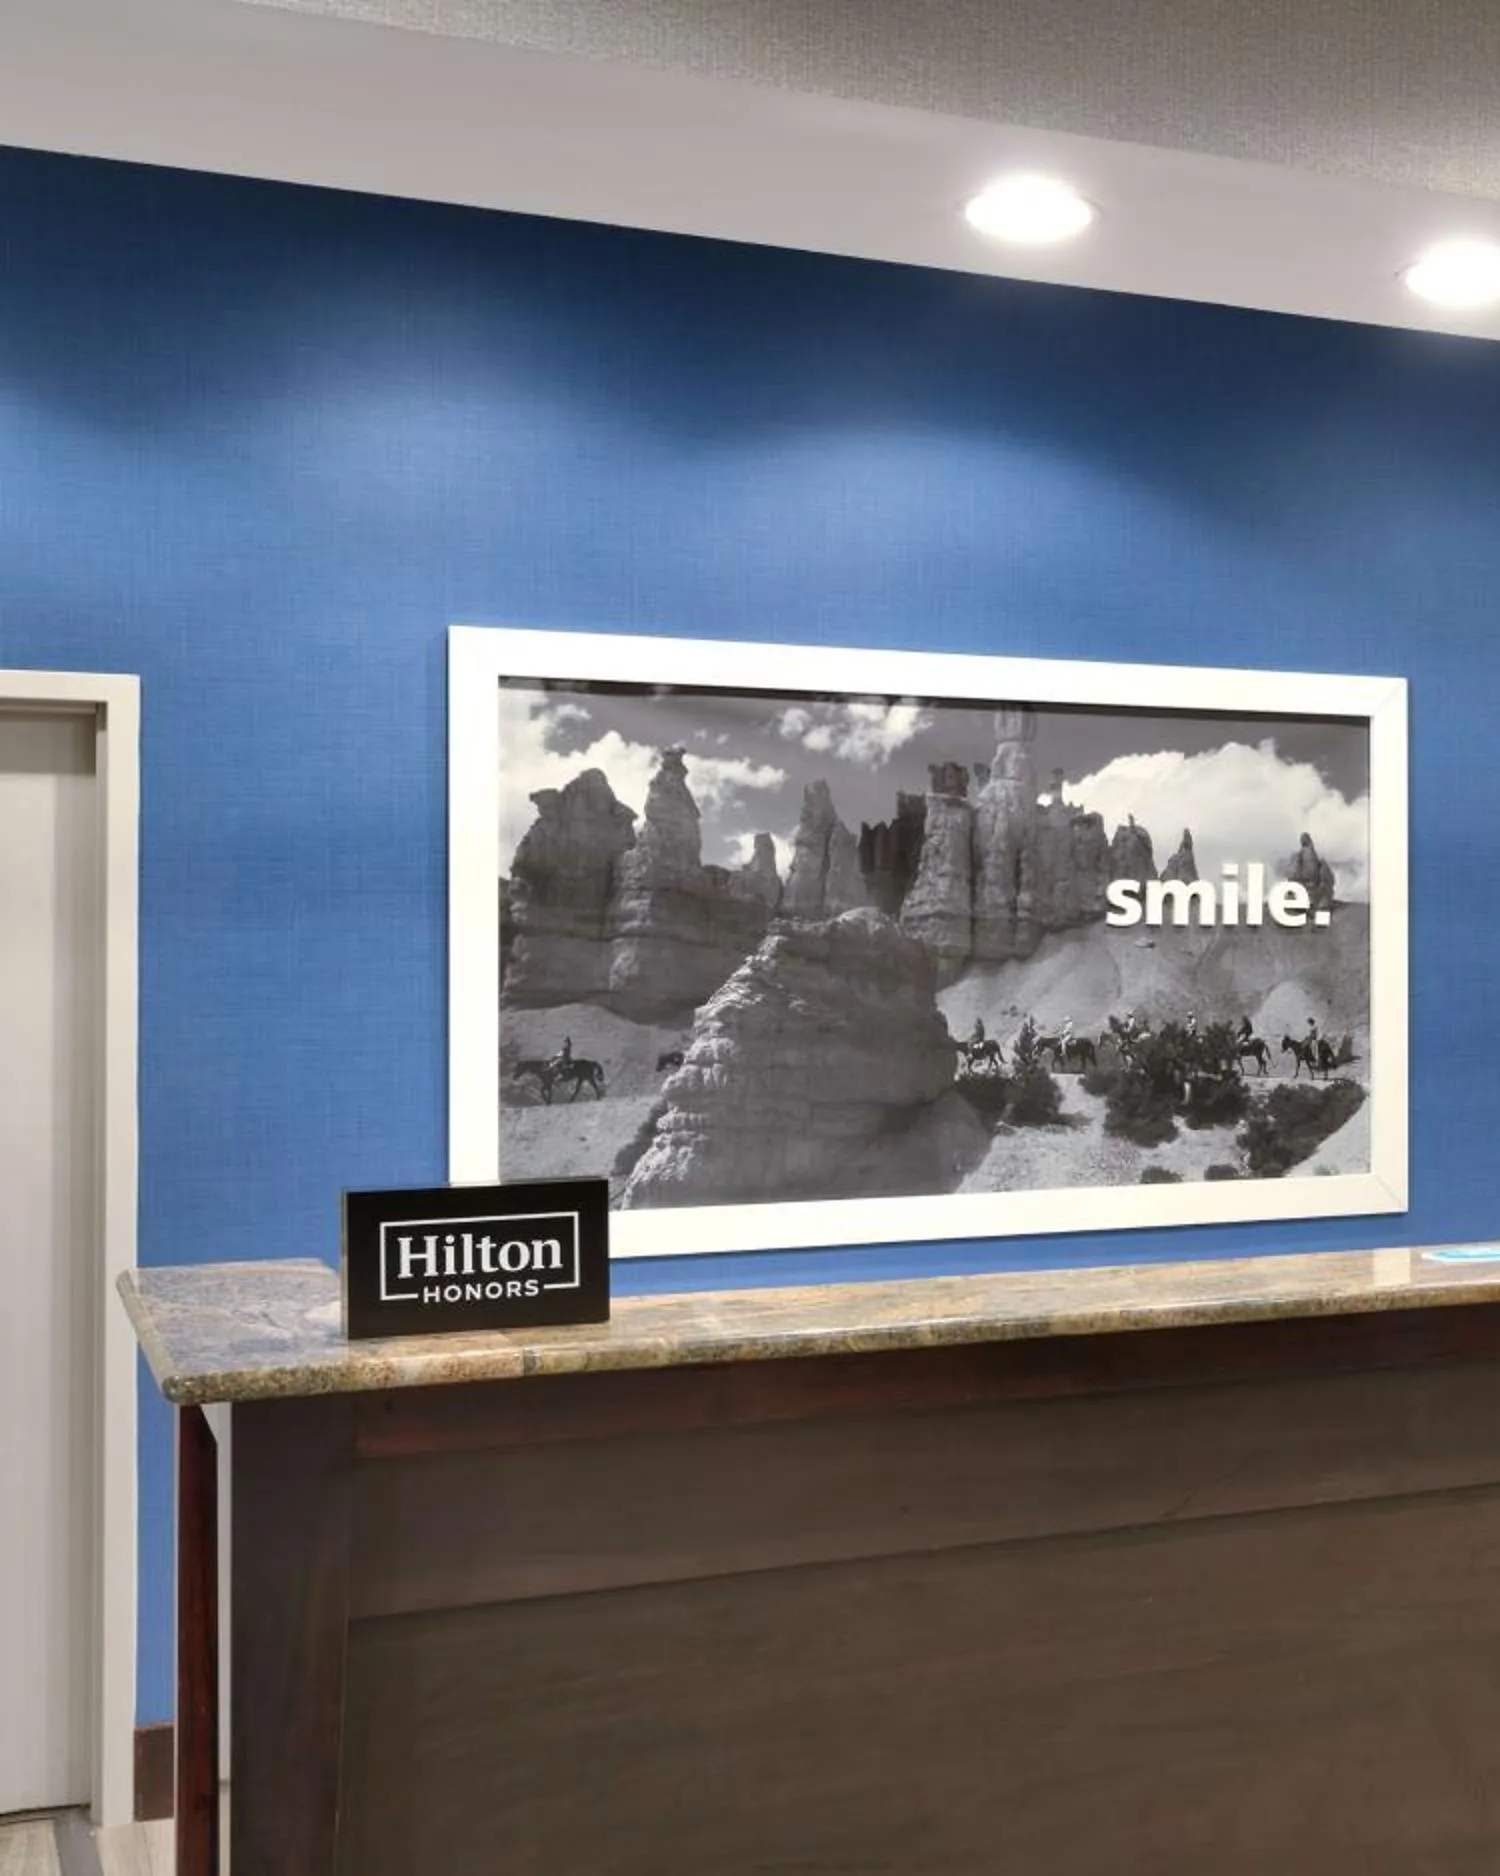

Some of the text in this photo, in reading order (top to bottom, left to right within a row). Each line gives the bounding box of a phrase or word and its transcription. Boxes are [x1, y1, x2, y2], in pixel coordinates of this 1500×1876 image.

[1105, 862, 1332, 927] smile.
[397, 1233, 563, 1279] Hilton
[423, 1279, 540, 1304] HONORS
